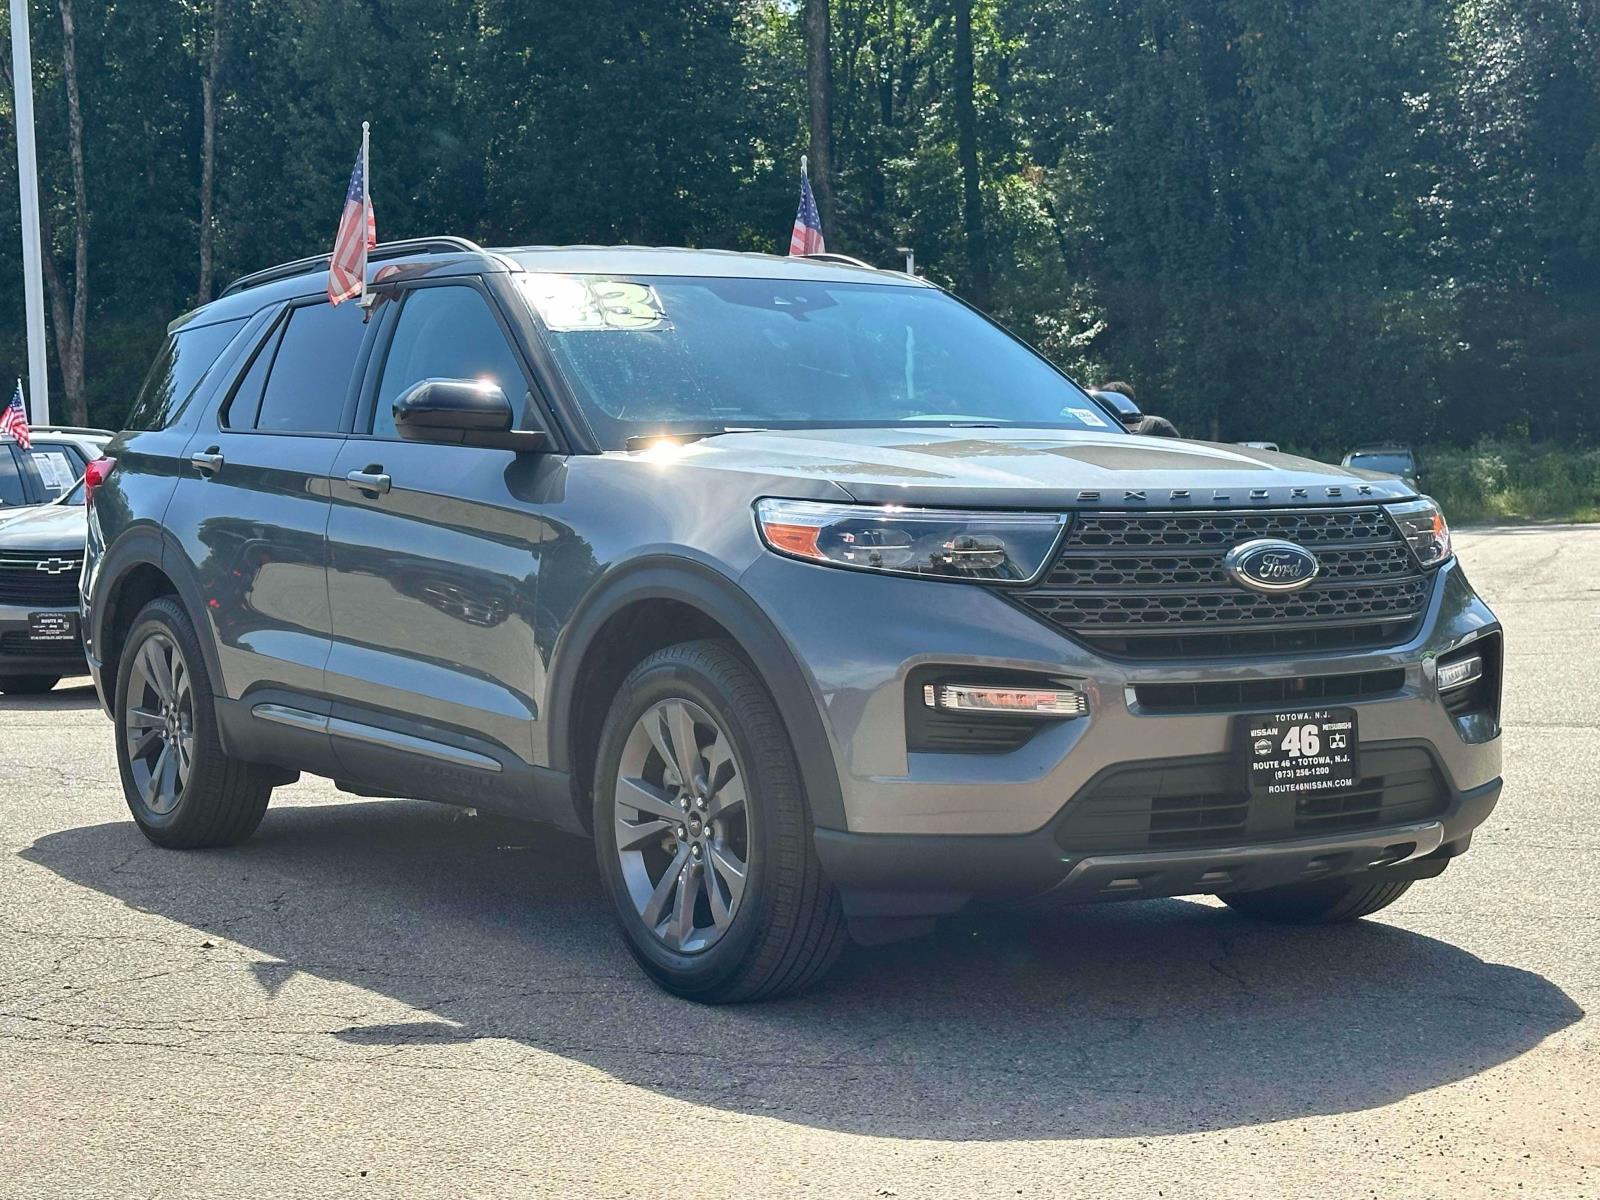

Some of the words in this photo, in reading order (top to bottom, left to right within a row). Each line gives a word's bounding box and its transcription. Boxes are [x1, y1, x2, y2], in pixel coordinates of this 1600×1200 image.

[1076, 485, 1373, 501] EXPLORER
[1259, 553, 1302, 579] Ford
[1314, 711, 1331, 720] N.J.
[1250, 728, 1278, 737] NISSAN
[1281, 724, 1320, 758] 46
[1253, 760, 1280, 770] ROUTE
[1281, 759, 1291, 768] 46
[1297, 757, 1333, 767] TOTOWA,
[1335, 755, 1350, 763] N.J.
[1275, 770, 1294, 780] (973)
[1269, 779, 1353, 793] ROUTE46NISSAN.COM
